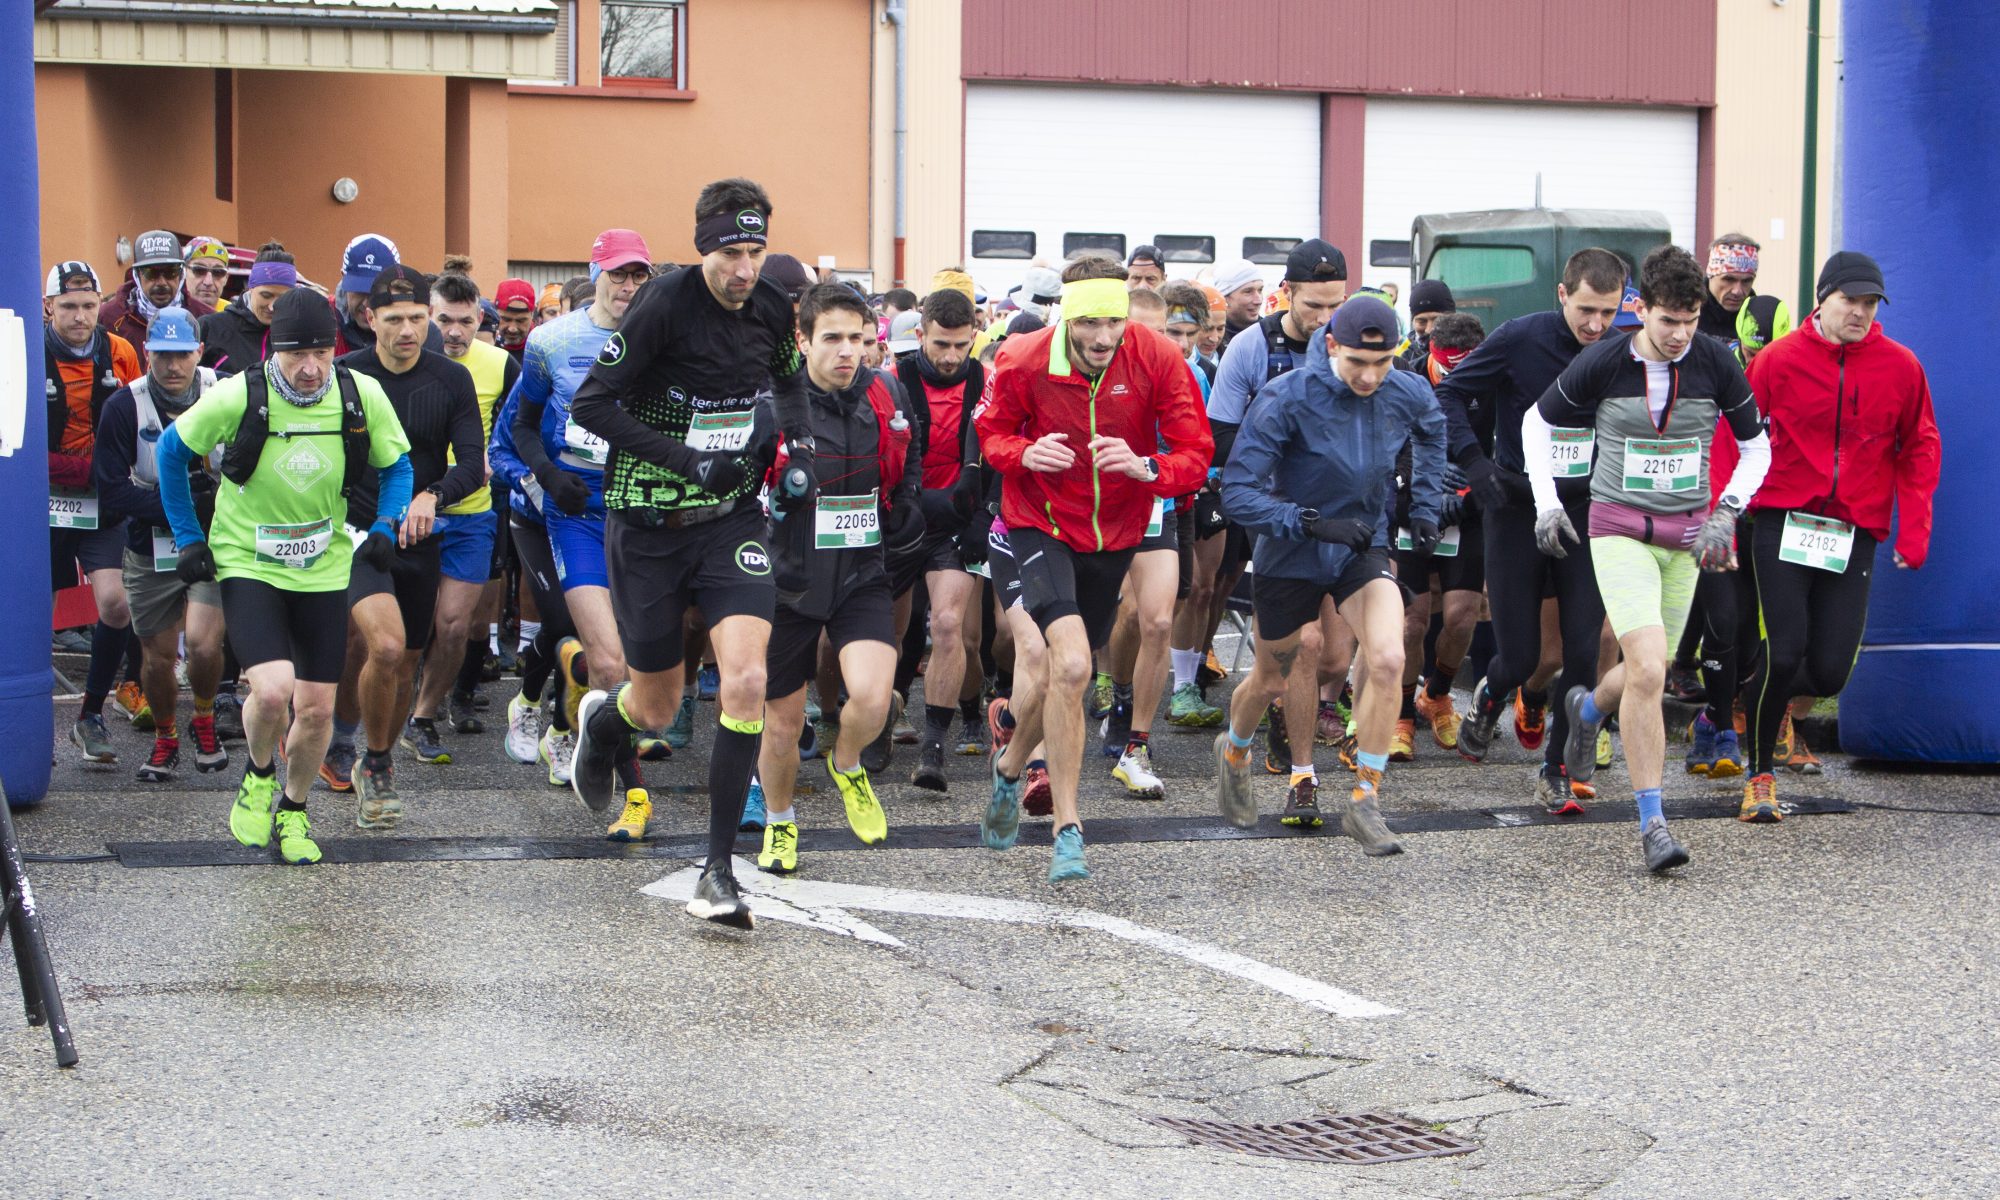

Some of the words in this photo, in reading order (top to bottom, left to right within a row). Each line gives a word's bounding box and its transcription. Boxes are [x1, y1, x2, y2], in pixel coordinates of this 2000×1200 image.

[141, 236, 171, 249] ATYPIK
[720, 233, 738, 242] terre
[603, 339, 620, 359] DR
[705, 432, 742, 450] 22114
[1643, 458, 1683, 474] 22167
[49, 499, 82, 513] 22202
[835, 512, 876, 529] 22069
[275, 539, 316, 556] 22003
[1800, 532, 1837, 552] 22182
[741, 551, 768, 567] TDR
